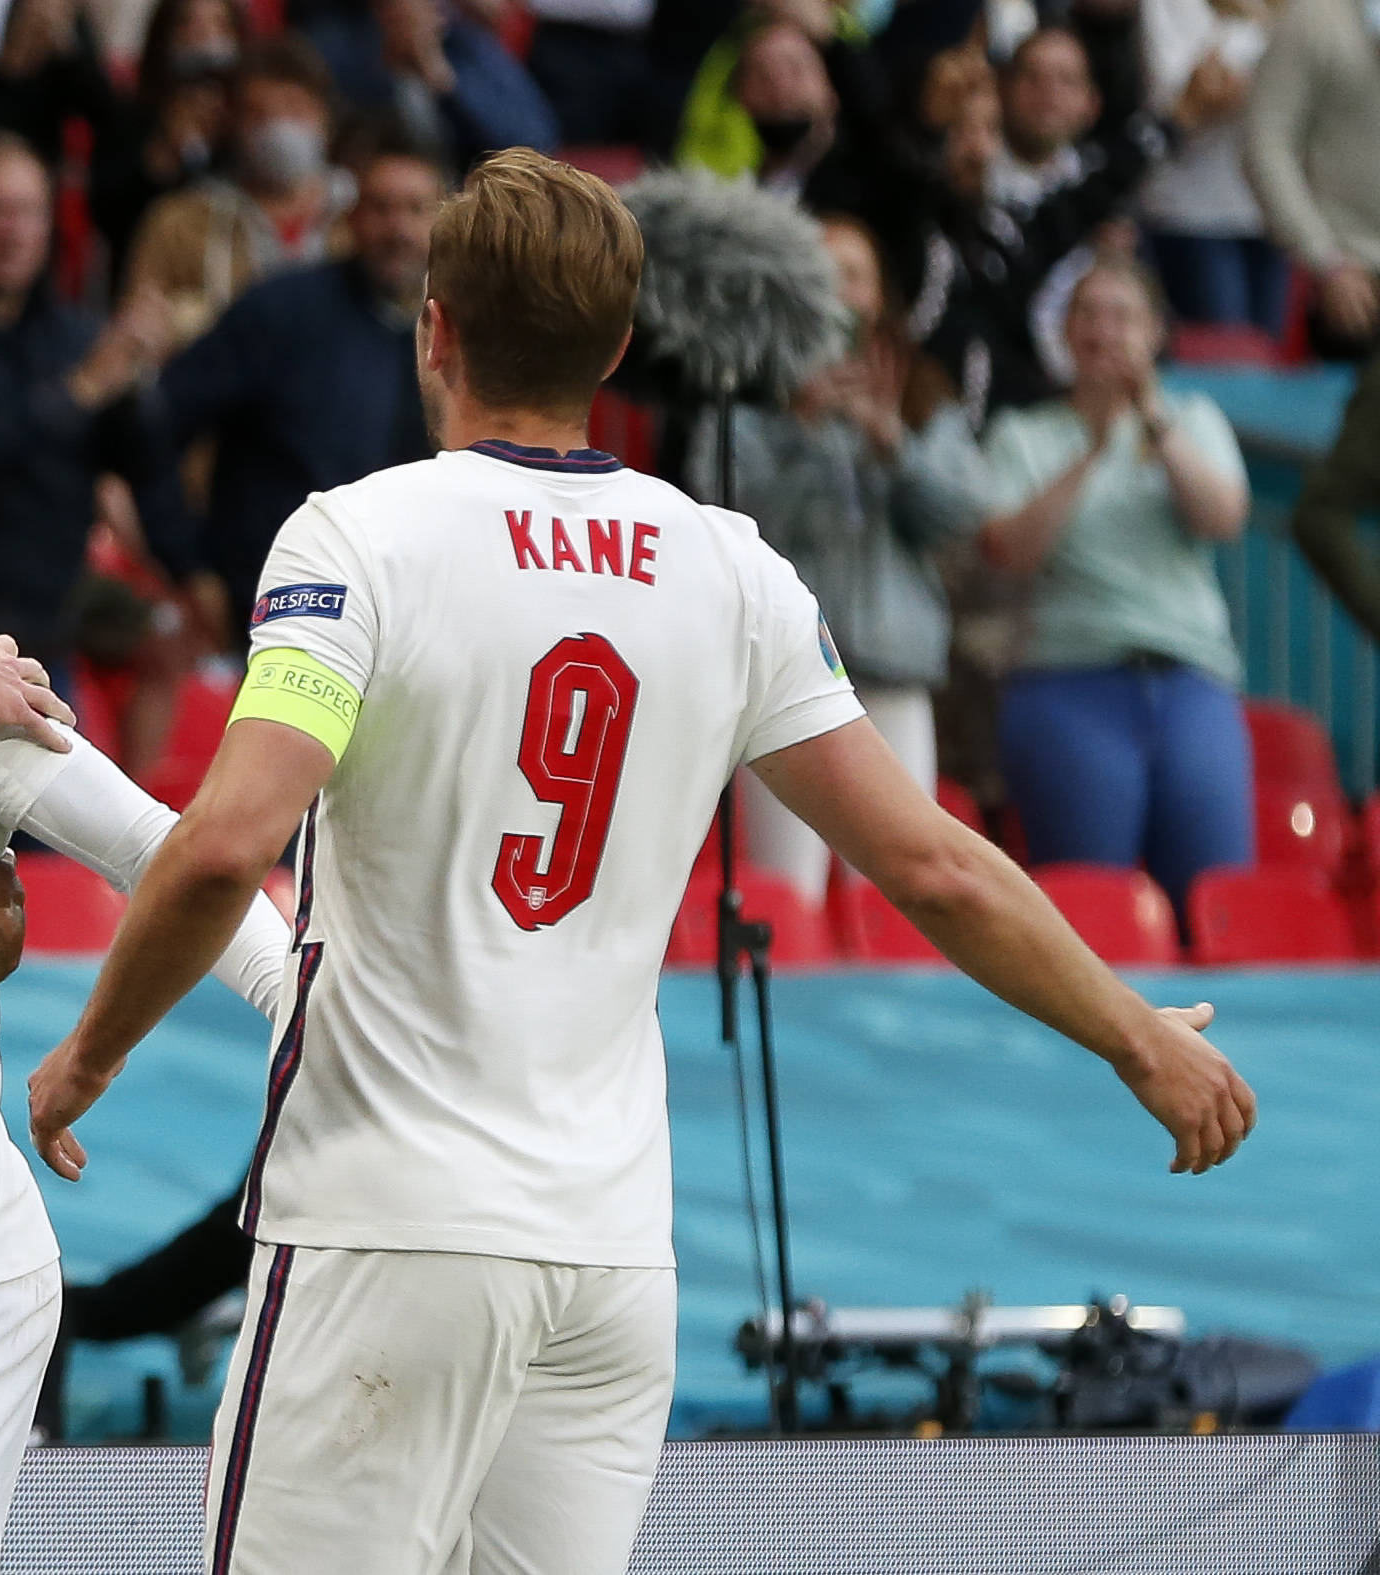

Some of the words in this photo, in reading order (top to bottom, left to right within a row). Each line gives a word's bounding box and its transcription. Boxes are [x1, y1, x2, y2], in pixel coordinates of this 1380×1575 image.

[504, 510, 661, 587] KANE
[269, 592, 344, 612] RESPECT
[491, 632, 641, 932] 9
